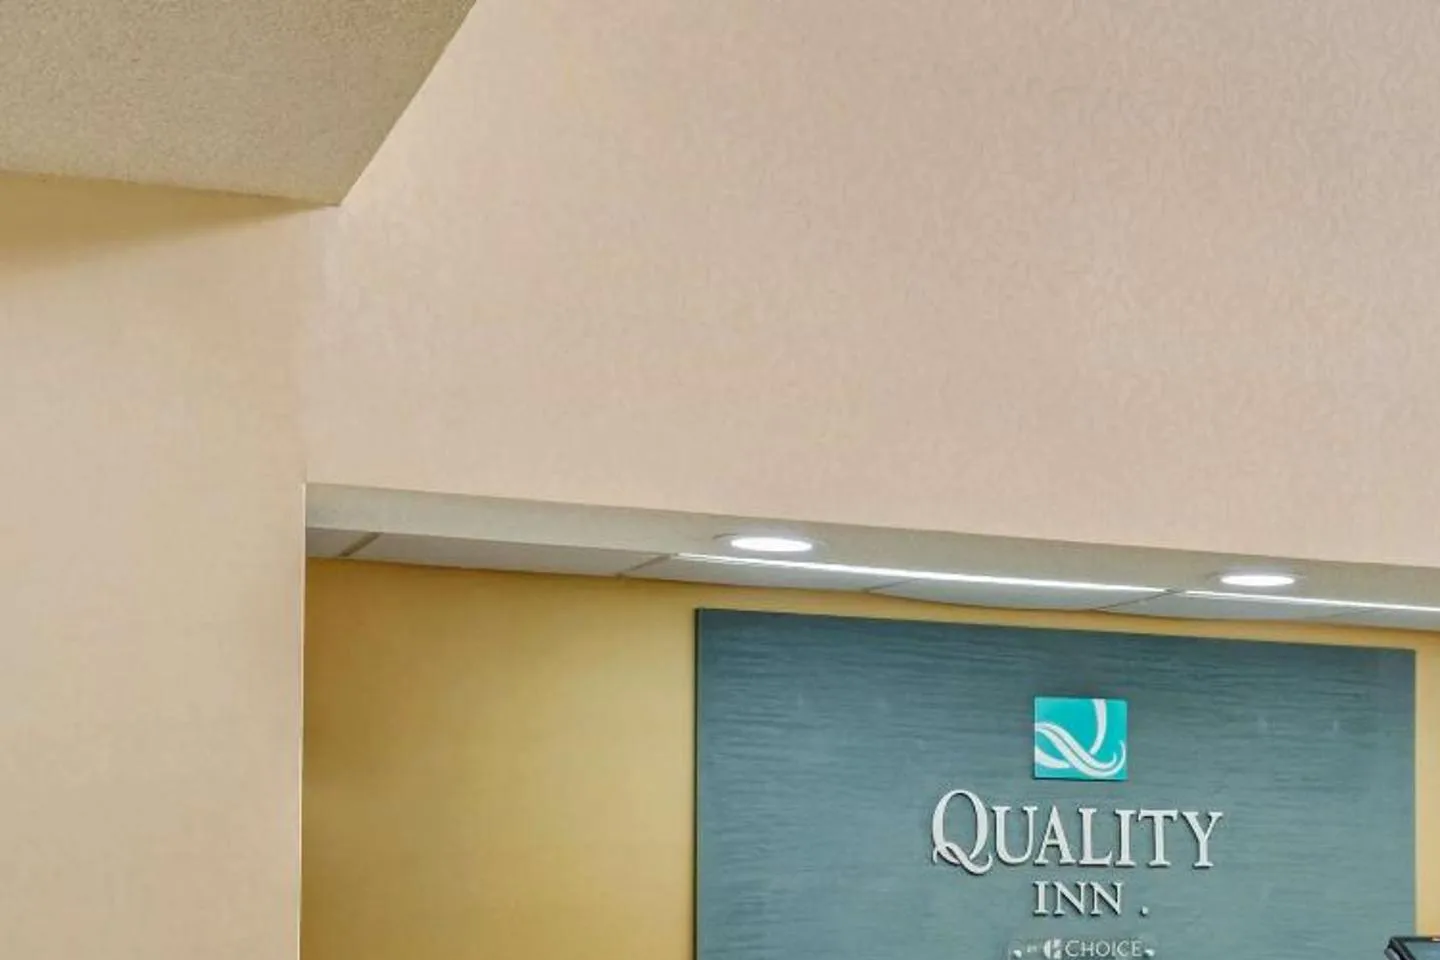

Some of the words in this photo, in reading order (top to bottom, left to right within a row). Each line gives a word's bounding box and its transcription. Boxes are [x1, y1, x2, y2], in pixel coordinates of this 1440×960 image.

[932, 789, 1223, 876] QUALITY
[1033, 881, 1122, 915] INN
[1065, 940, 1143, 957] CHOICE
